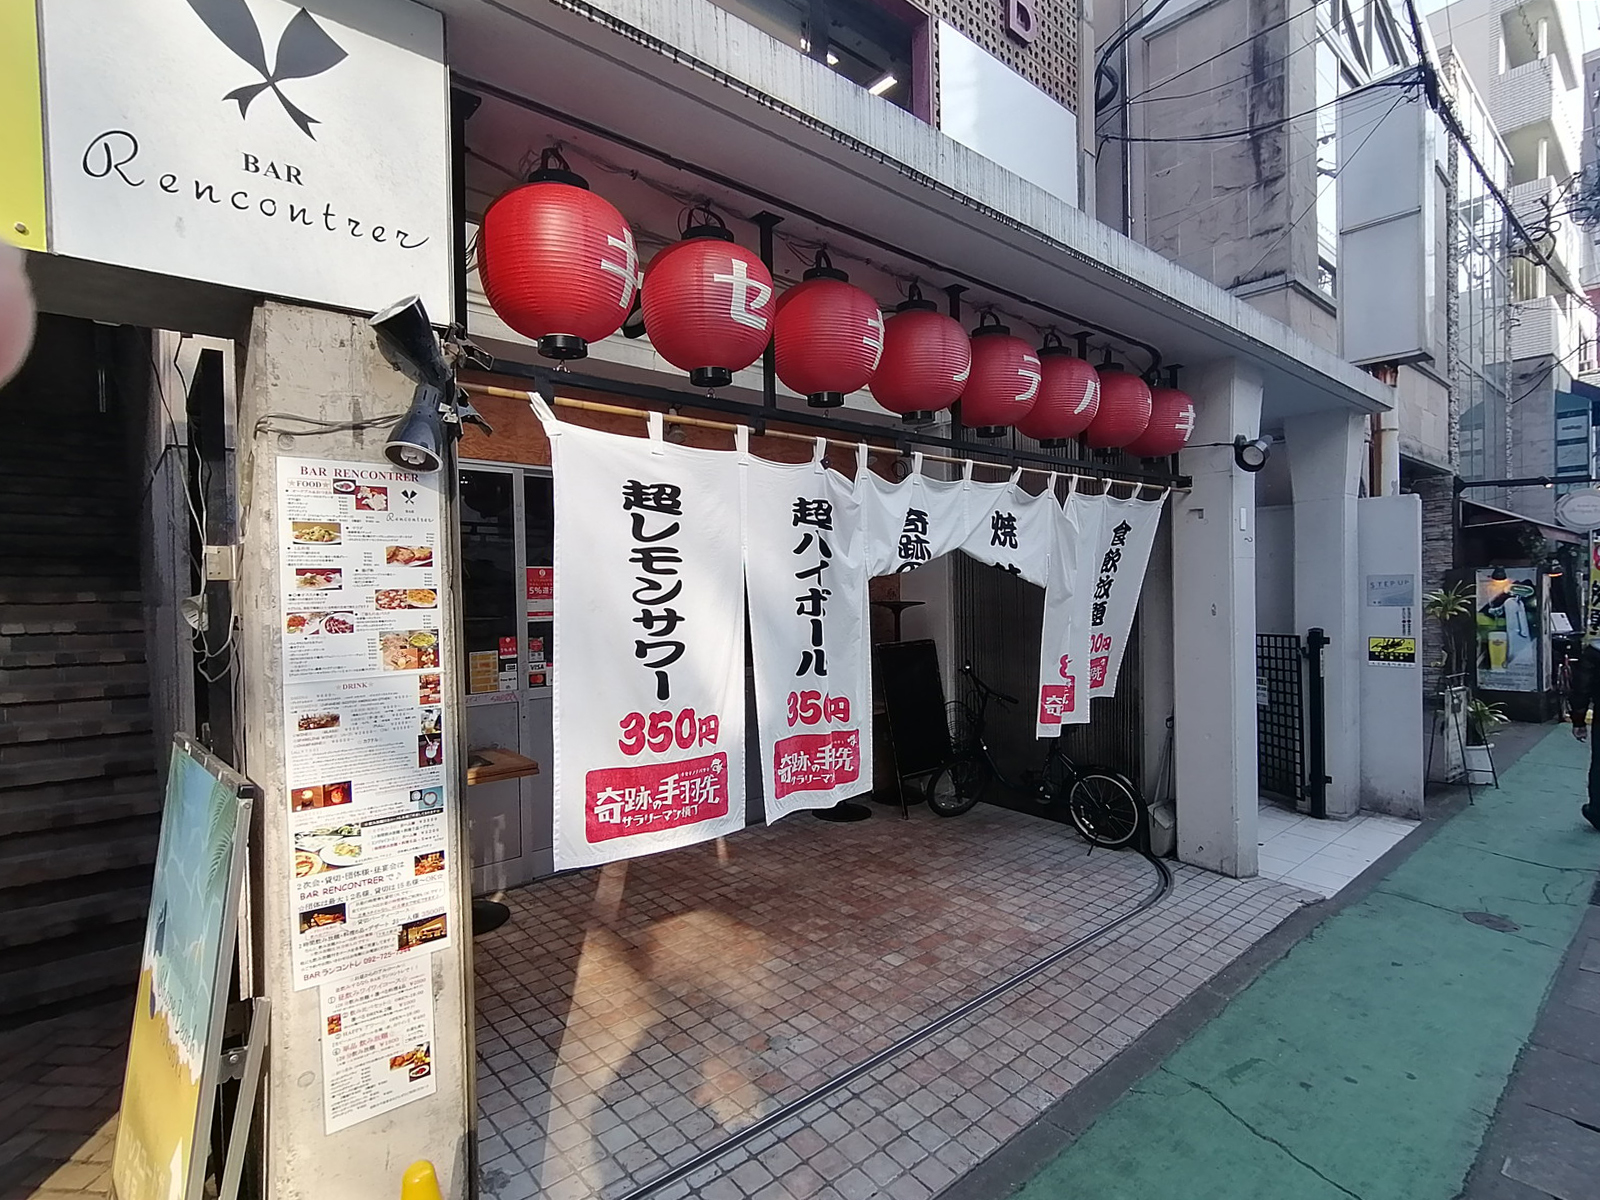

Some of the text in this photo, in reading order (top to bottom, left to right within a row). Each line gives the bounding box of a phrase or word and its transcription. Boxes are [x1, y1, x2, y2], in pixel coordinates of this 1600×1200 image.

[82, 130, 430, 249] Rencontrer
[241, 152, 305, 186] BAR
[713, 258, 772, 331] セ
[296, 480, 322, 488] FOOD
[300, 466, 419, 483] BAR RENCONTRER
[622, 479, 685, 701] 超レモンサワー
[791, 497, 834, 677] 超ハイボール
[342, 682, 368, 690] DRINK
[618, 708, 719, 756] 350円
[593, 774, 721, 824] 奇跡の手羽先
[299, 890, 319, 900] BAR
[322, 876, 384, 895] RENCONTRER
[303, 970, 321, 981] BAR
[322, 960, 362, 977] ランコントレ
